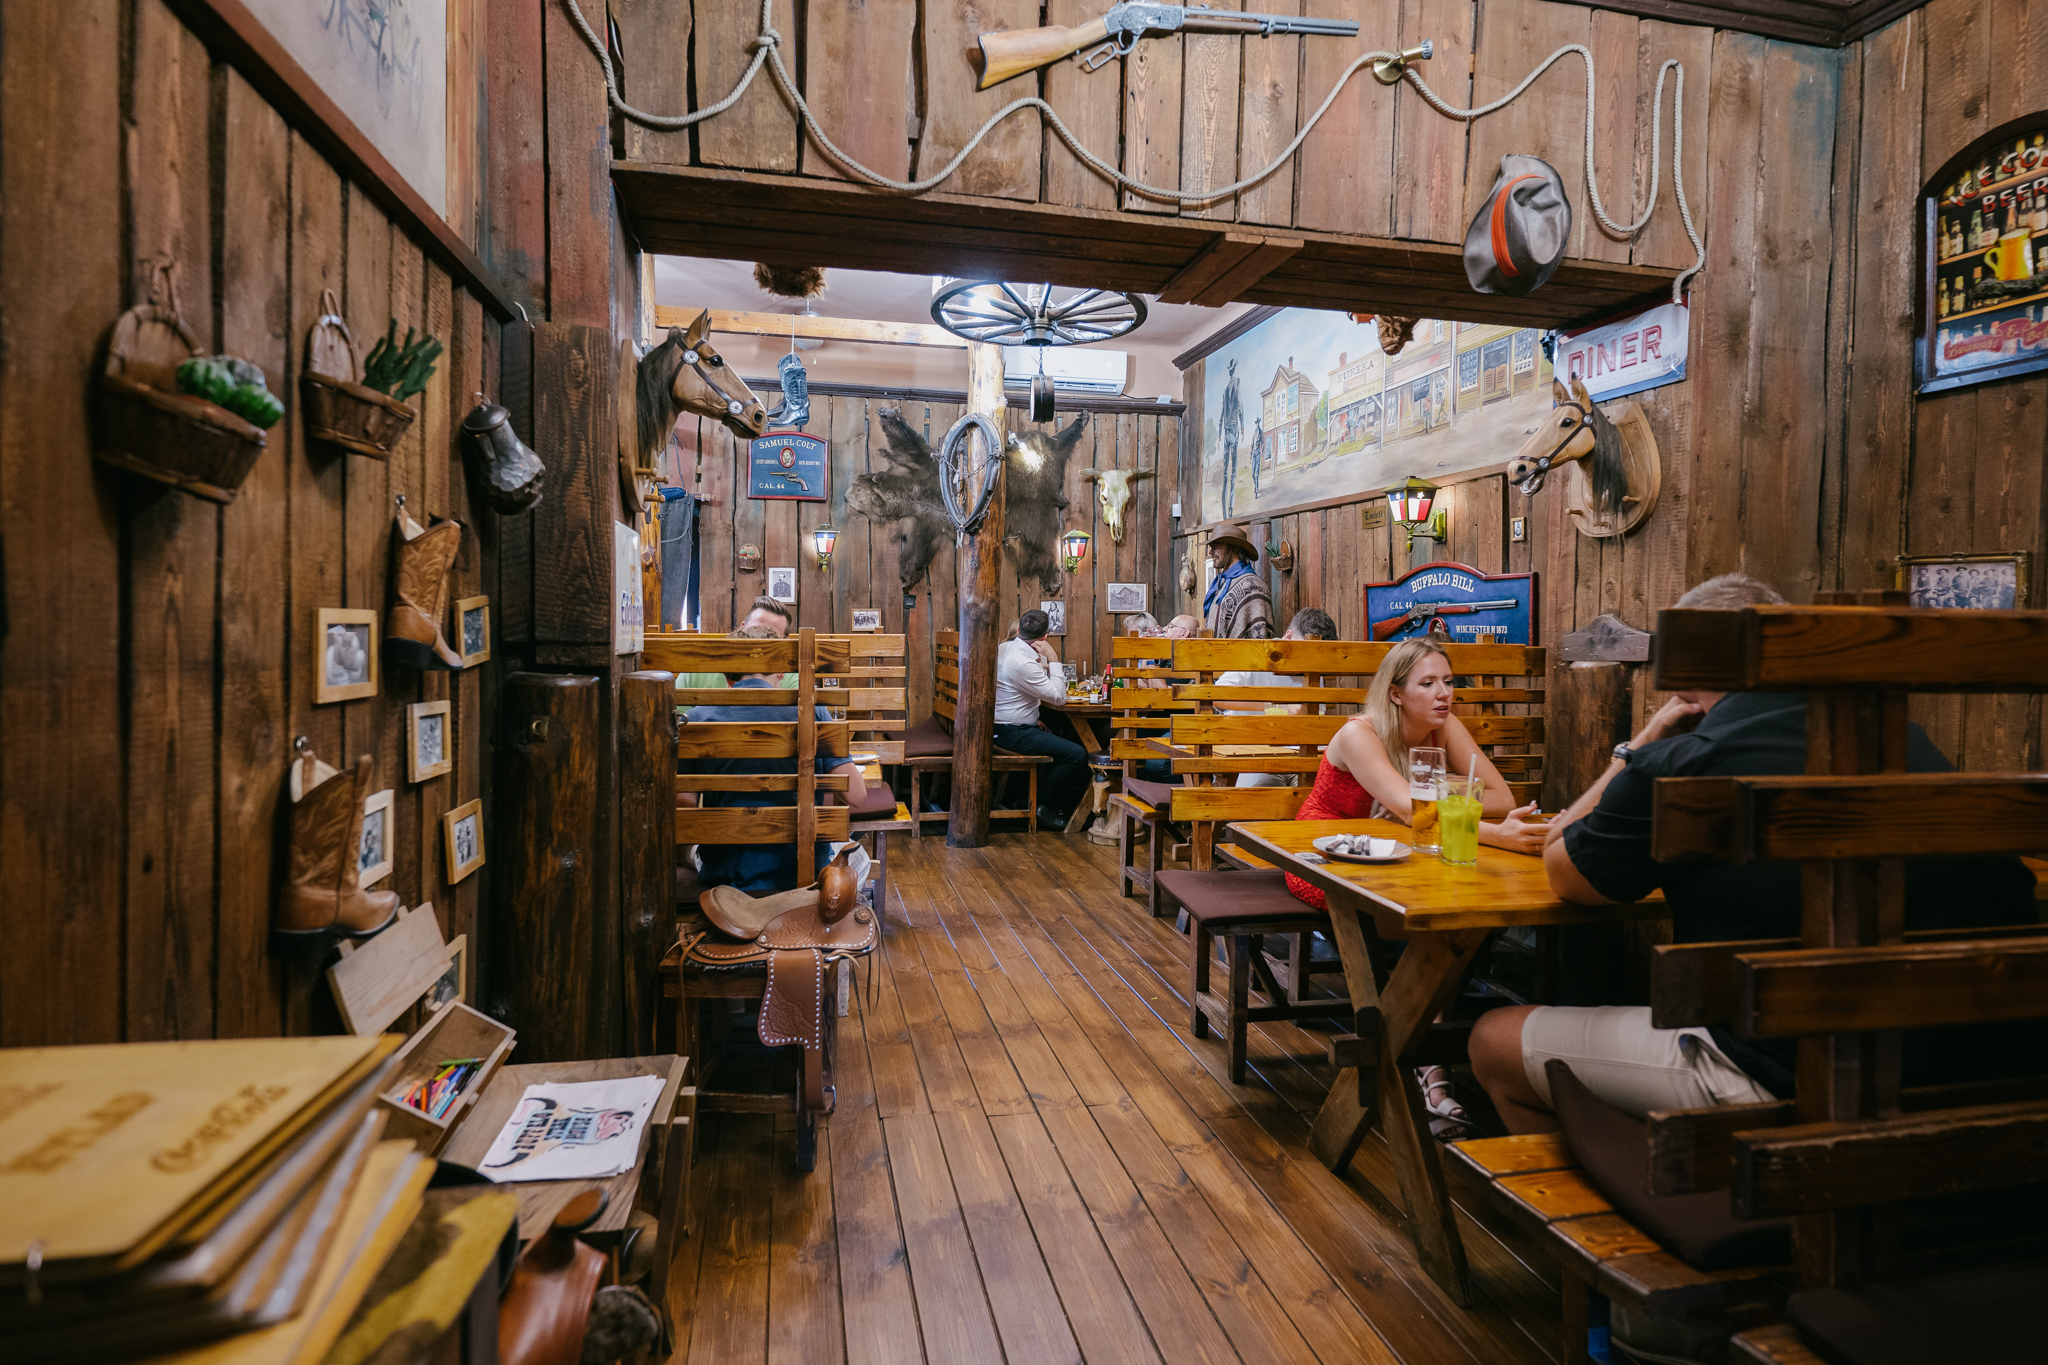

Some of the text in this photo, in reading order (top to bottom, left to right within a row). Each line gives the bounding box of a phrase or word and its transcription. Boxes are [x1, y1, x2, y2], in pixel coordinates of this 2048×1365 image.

[1949, 166, 1994, 207] ICE
[1982, 177, 2048, 213] BEER
[1568, 325, 1662, 385] DINER
[1949, 340, 1999, 358] Draught
[1337, 359, 1375, 383] EUREKA
[759, 438, 817, 450] SAMUEL COLT
[1410, 573, 1475, 593] BUFFALO BILL
[1390, 601, 1412, 610] CAL. 44
[1456, 625, 1490, 634] WINCHESTER
